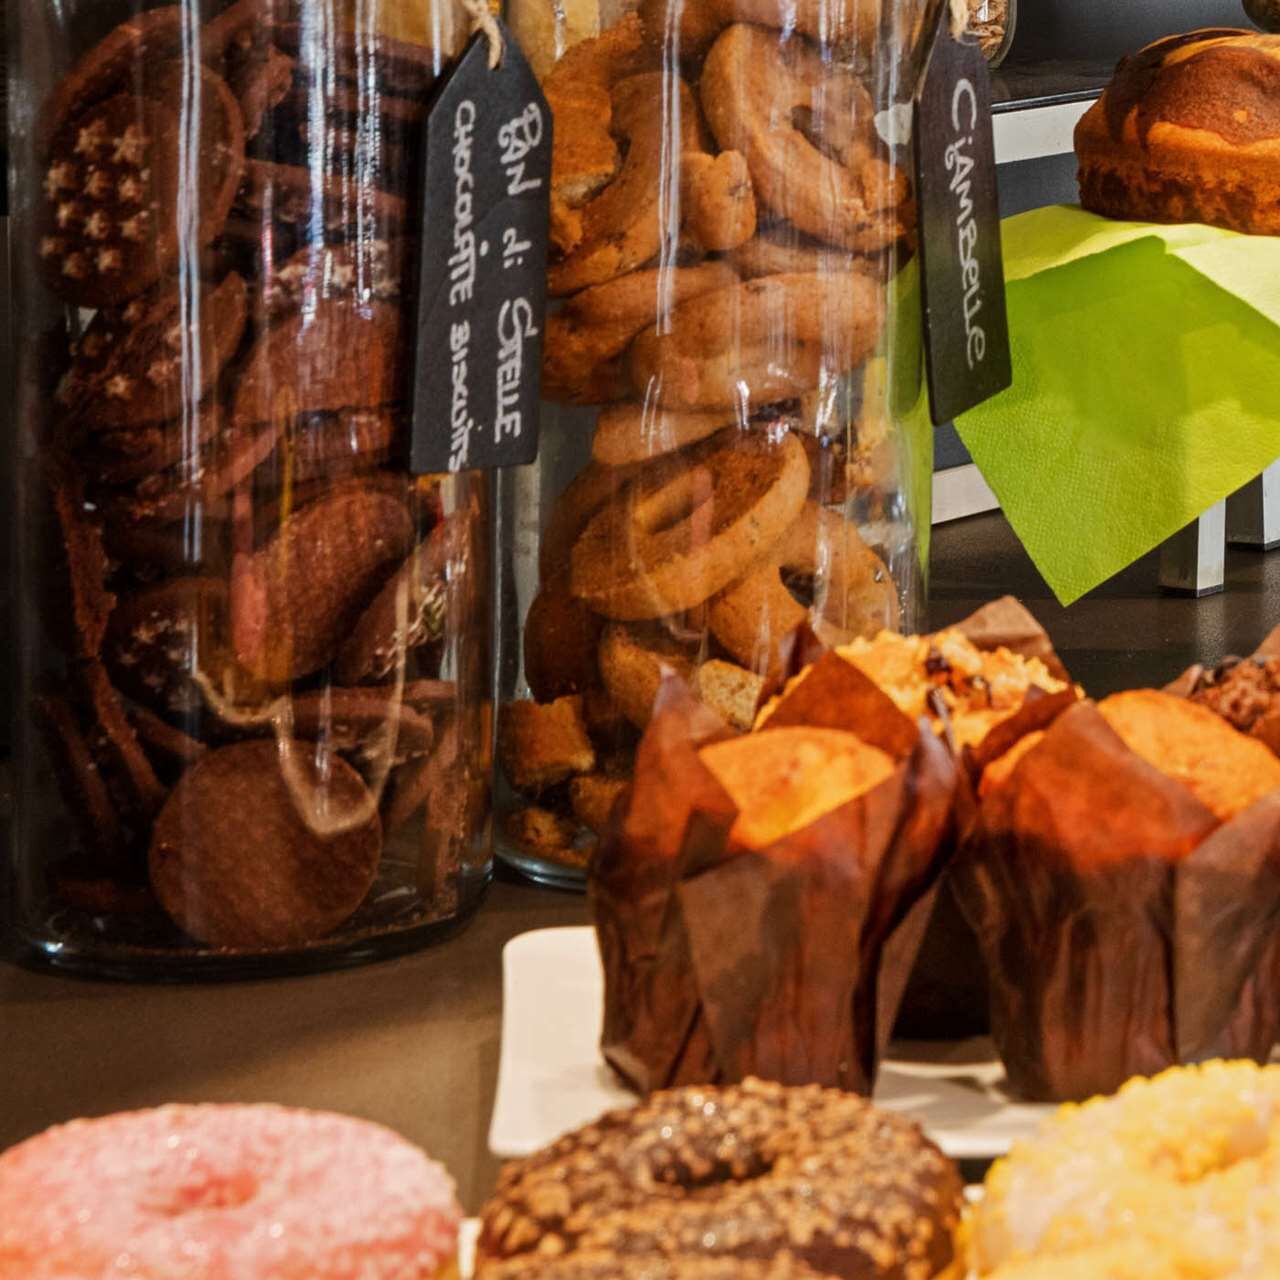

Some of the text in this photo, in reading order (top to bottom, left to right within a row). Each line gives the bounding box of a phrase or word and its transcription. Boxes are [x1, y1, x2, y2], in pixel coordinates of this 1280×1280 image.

[493, 101, 543, 446] PAN di STELLE
